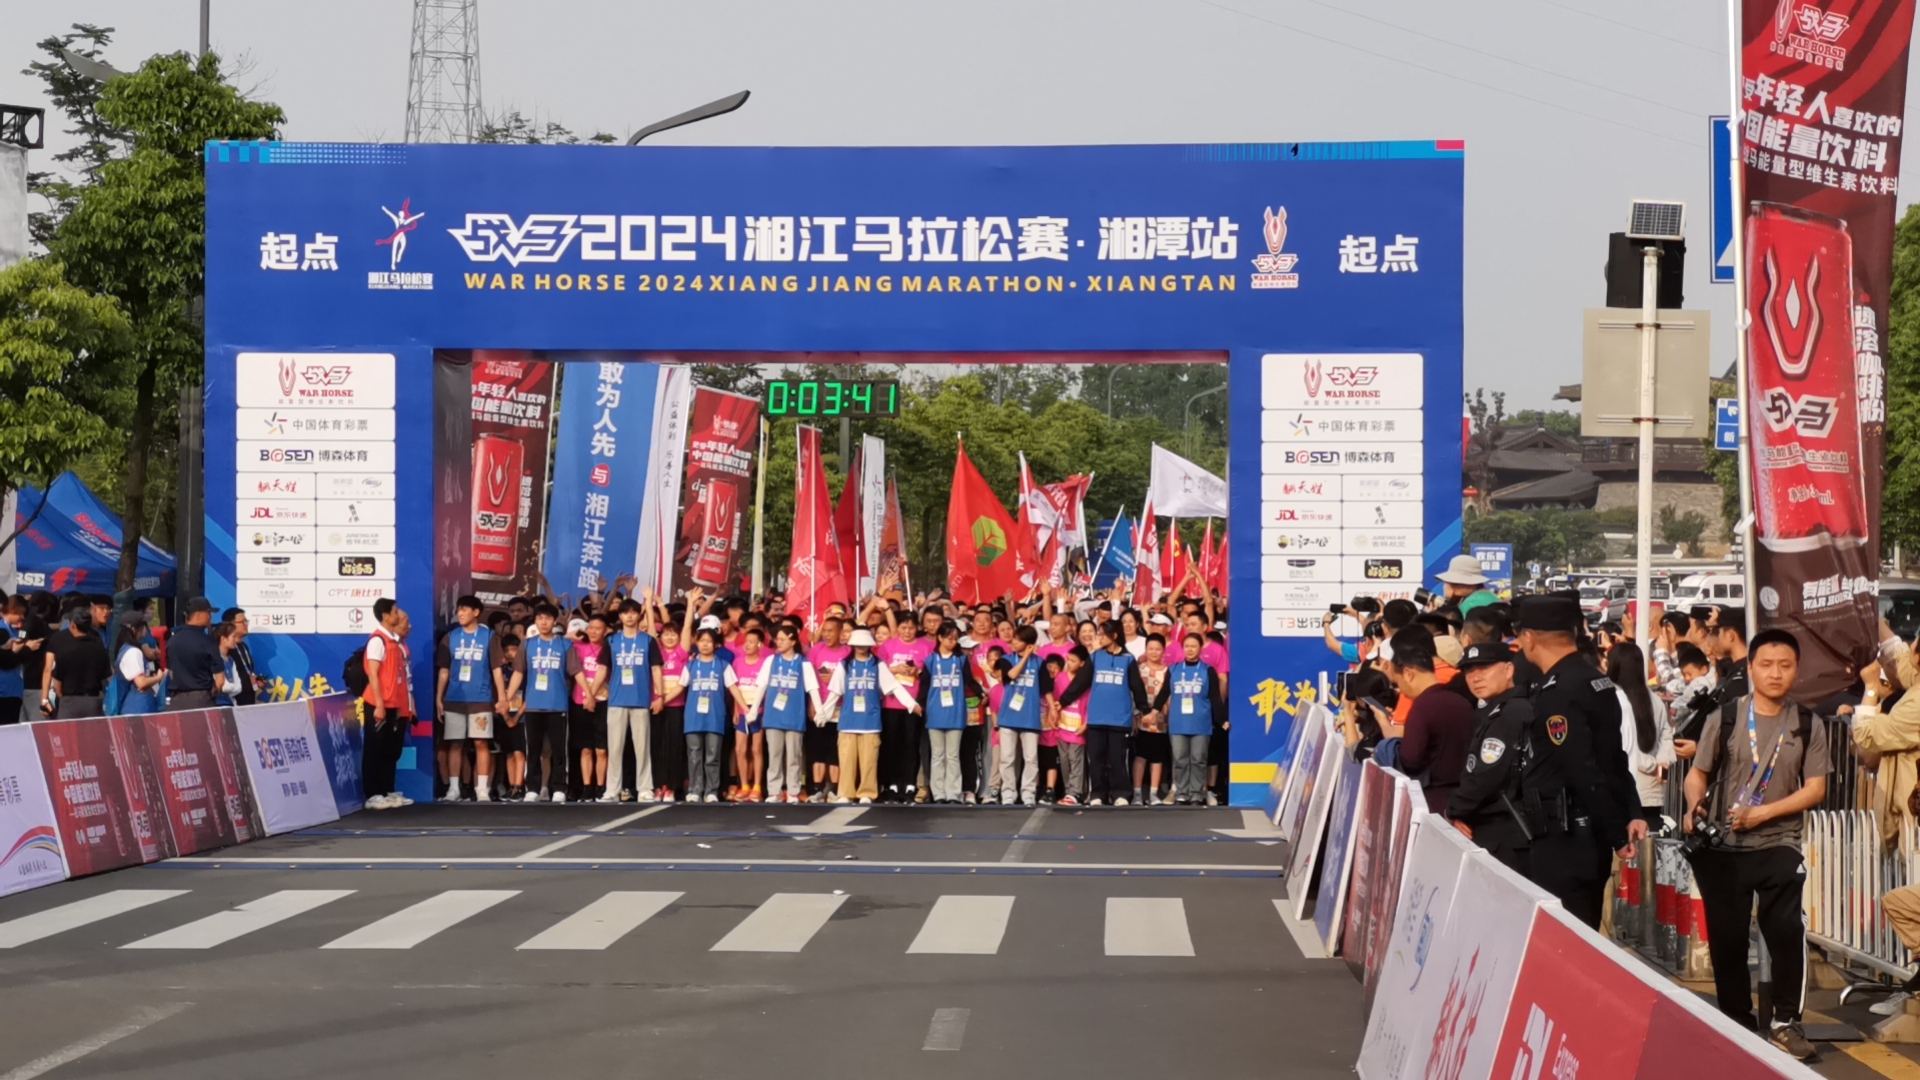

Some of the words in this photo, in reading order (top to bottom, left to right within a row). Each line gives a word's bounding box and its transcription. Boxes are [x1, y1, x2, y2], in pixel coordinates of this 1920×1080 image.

[1789, 34, 1810, 51] WAR
[1810, 41, 1845, 61] HORSE
[1742, 73, 1901, 137] 受年轻人喜欢的
[1744, 109, 1888, 172] 国能量饮料
[260, 232, 339, 271] 起点
[1338, 235, 1419, 273] 起点
[464, 273, 524, 291] WAR
[535, 273, 624, 291] HORSE
[1088, 274, 1236, 291] XIANGTAN
[590, 362, 624, 457] 敢为人先
[768, 382, 895, 414] 0:03:41
[293, 419, 368, 431] 中国体育彩票
[668, 400, 680, 441] 公益体彩
[1318, 420, 1395, 432] 中国体育彩票
[259, 449, 314, 462] BOSEN
[319, 450, 368, 462] 博森体育
[1285, 451, 1340, 464] BOSEN
[1345, 451, 1395, 463] 博森体育
[592, 467, 607, 482] 与
[250, 507, 274, 518] JDL
[1275, 509, 1299, 520] JDL
[577, 492, 610, 590] 湘江奔跑
[328, 589, 350, 597] CPT
[351, 588, 382, 597] 康比特
[1803, 598, 1827, 610] WAR
[266, 673, 335, 703] 为人先
[1250, 678, 1340, 735] 敢为
